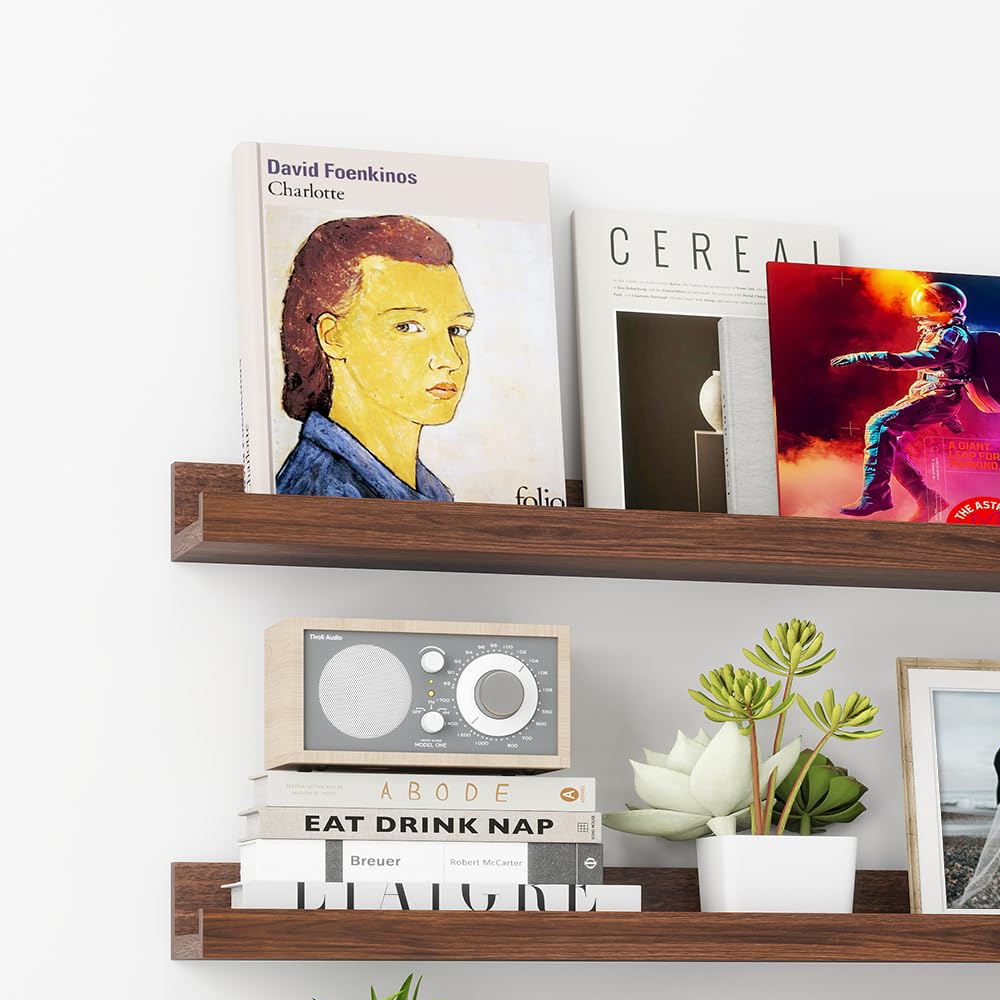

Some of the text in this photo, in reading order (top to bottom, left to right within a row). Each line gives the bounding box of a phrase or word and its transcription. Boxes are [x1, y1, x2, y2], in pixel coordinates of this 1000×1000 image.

[267, 158, 418, 184] David Foenkinos
[268, 181, 345, 200] Charlotte
[948, 441, 991, 451] A GIANT
[979, 452, 1000, 461] FOR
[515, 486, 565, 507] folio
[954, 504, 975, 520] THE
[381, 781, 510, 803] ABODE
[304, 815, 554, 835] EAT DRINK NAP
[350, 855, 401, 867] Breuer
[450, 859, 522, 867] Robert McCarter
